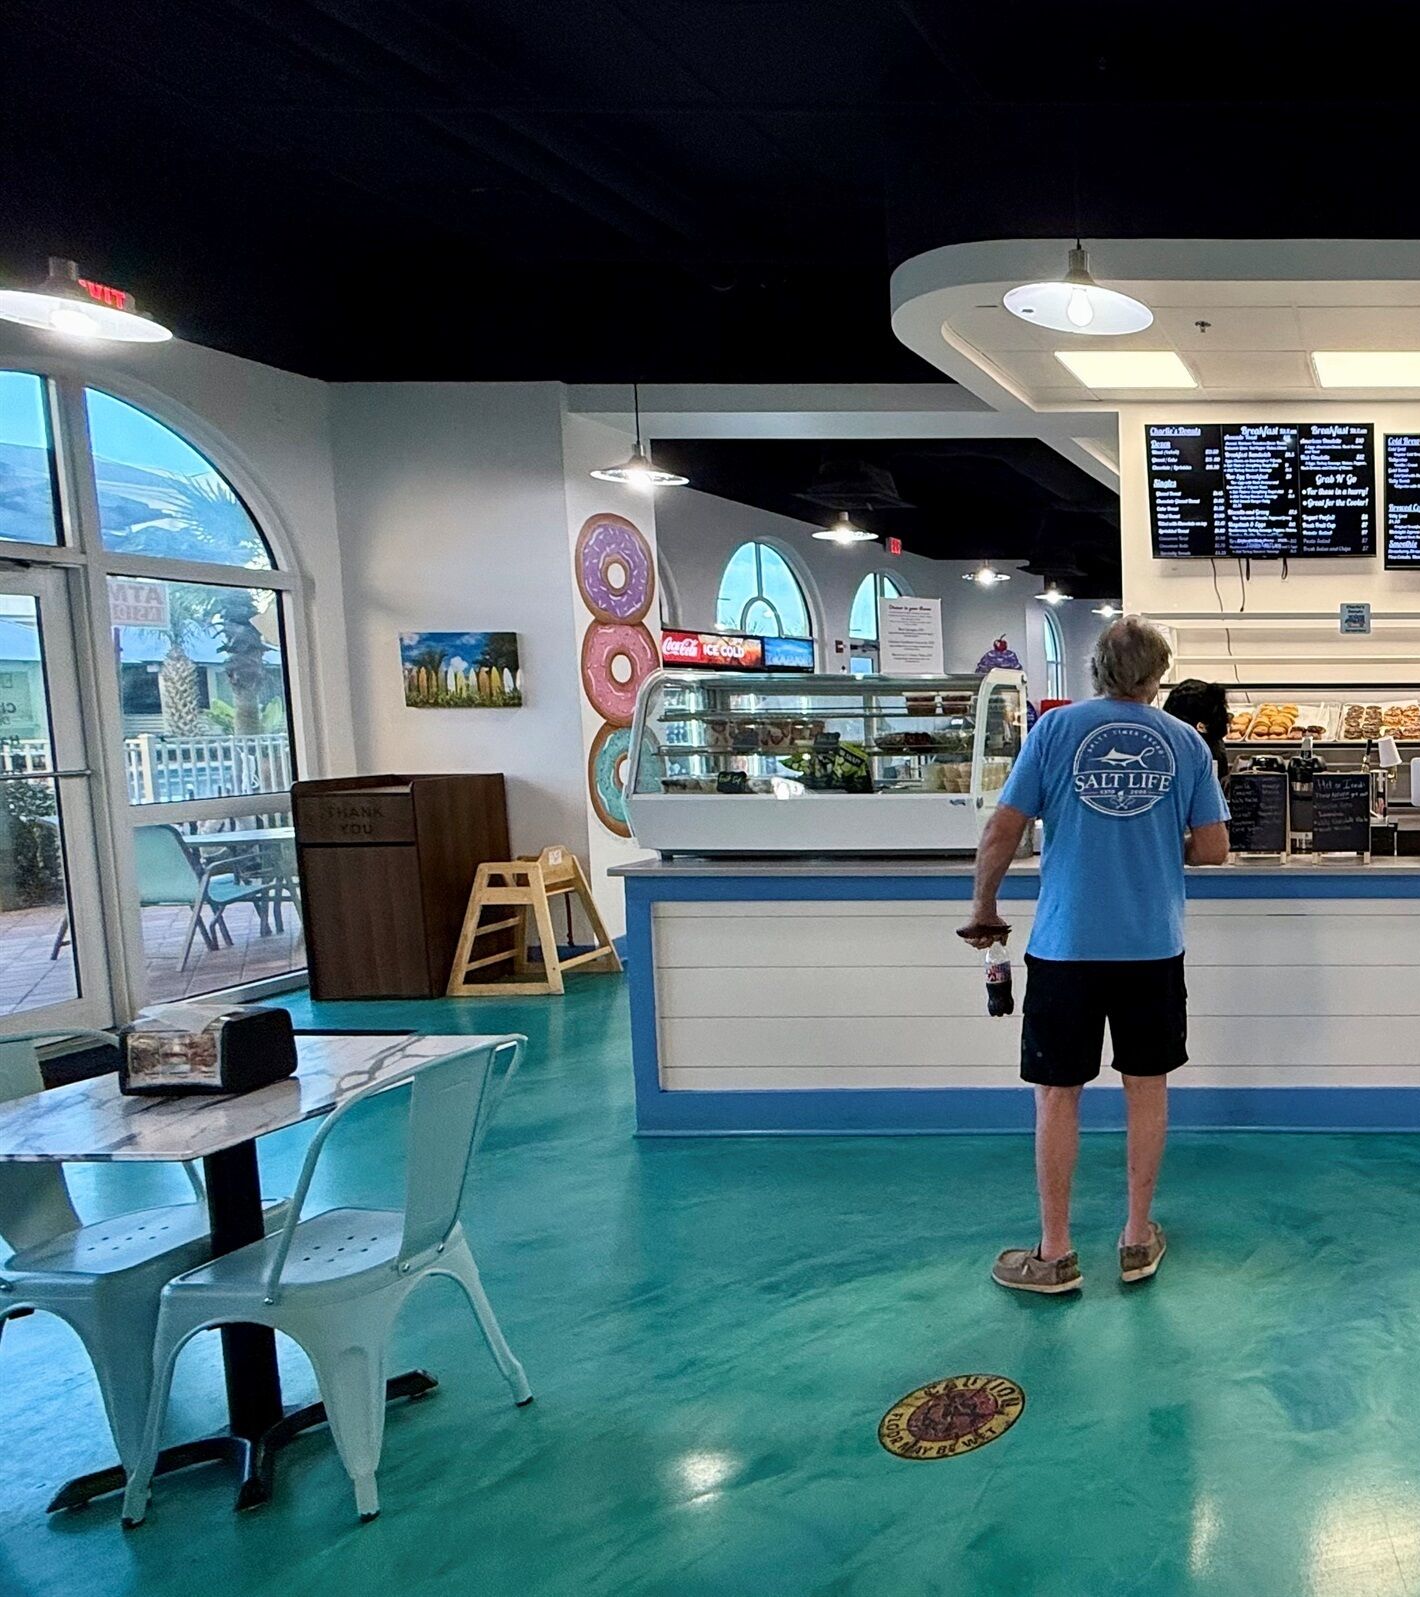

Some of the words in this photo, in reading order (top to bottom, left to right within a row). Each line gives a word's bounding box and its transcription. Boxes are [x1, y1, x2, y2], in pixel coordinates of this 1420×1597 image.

[78, 279, 126, 310] XIT
[1241, 426, 1279, 437] Breakfast
[1311, 425, 1349, 437] Breakfast
[1388, 437, 1403, 446] Cold
[1315, 474, 1335, 485] Grab
[1346, 474, 1357, 485] Go
[1334, 487, 1342, 495] in
[1307, 498, 1325, 508] Great
[1324, 498, 1335, 508] for
[703, 644, 719, 657] ICE
[721, 645, 745, 658] COLD
[1074, 773, 1124, 792] SALT
[1127, 773, 1172, 792] LIFE
[326, 805, 385, 818] THANK
[341, 824, 373, 834] YOU
